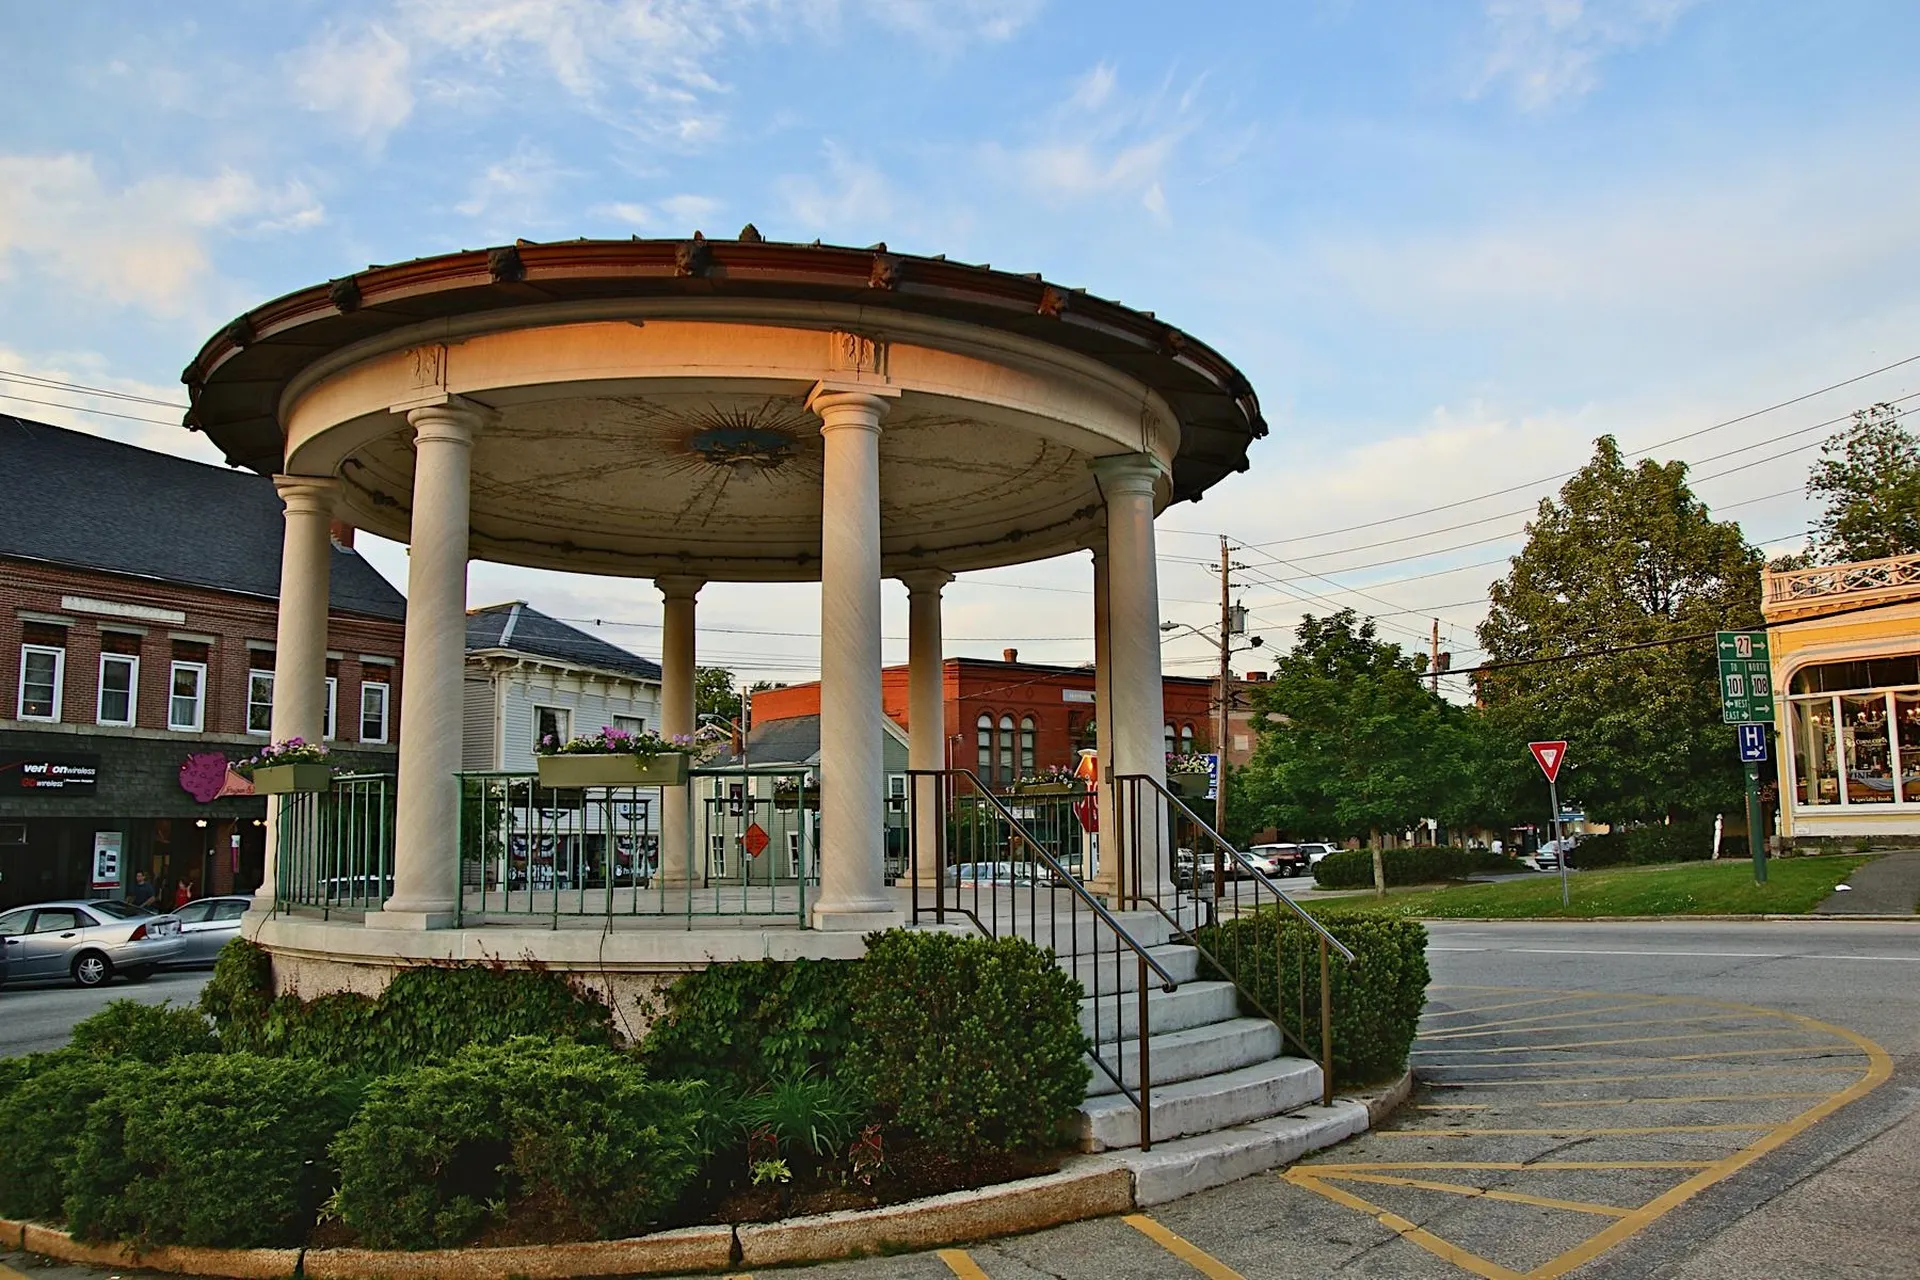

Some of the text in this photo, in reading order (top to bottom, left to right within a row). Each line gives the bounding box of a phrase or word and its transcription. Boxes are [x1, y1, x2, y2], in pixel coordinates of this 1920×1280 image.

[1737, 637, 1749, 654] 27
[1730, 662, 1738, 672] TO
[1748, 662, 1767, 672] NORTH
[1728, 678, 1743, 695] 101
[1753, 678, 1769, 695] 108
[1734, 699, 1748, 709] WEST
[1725, 710, 1740, 720] EAST
[1745, 726, 1759, 747] H
